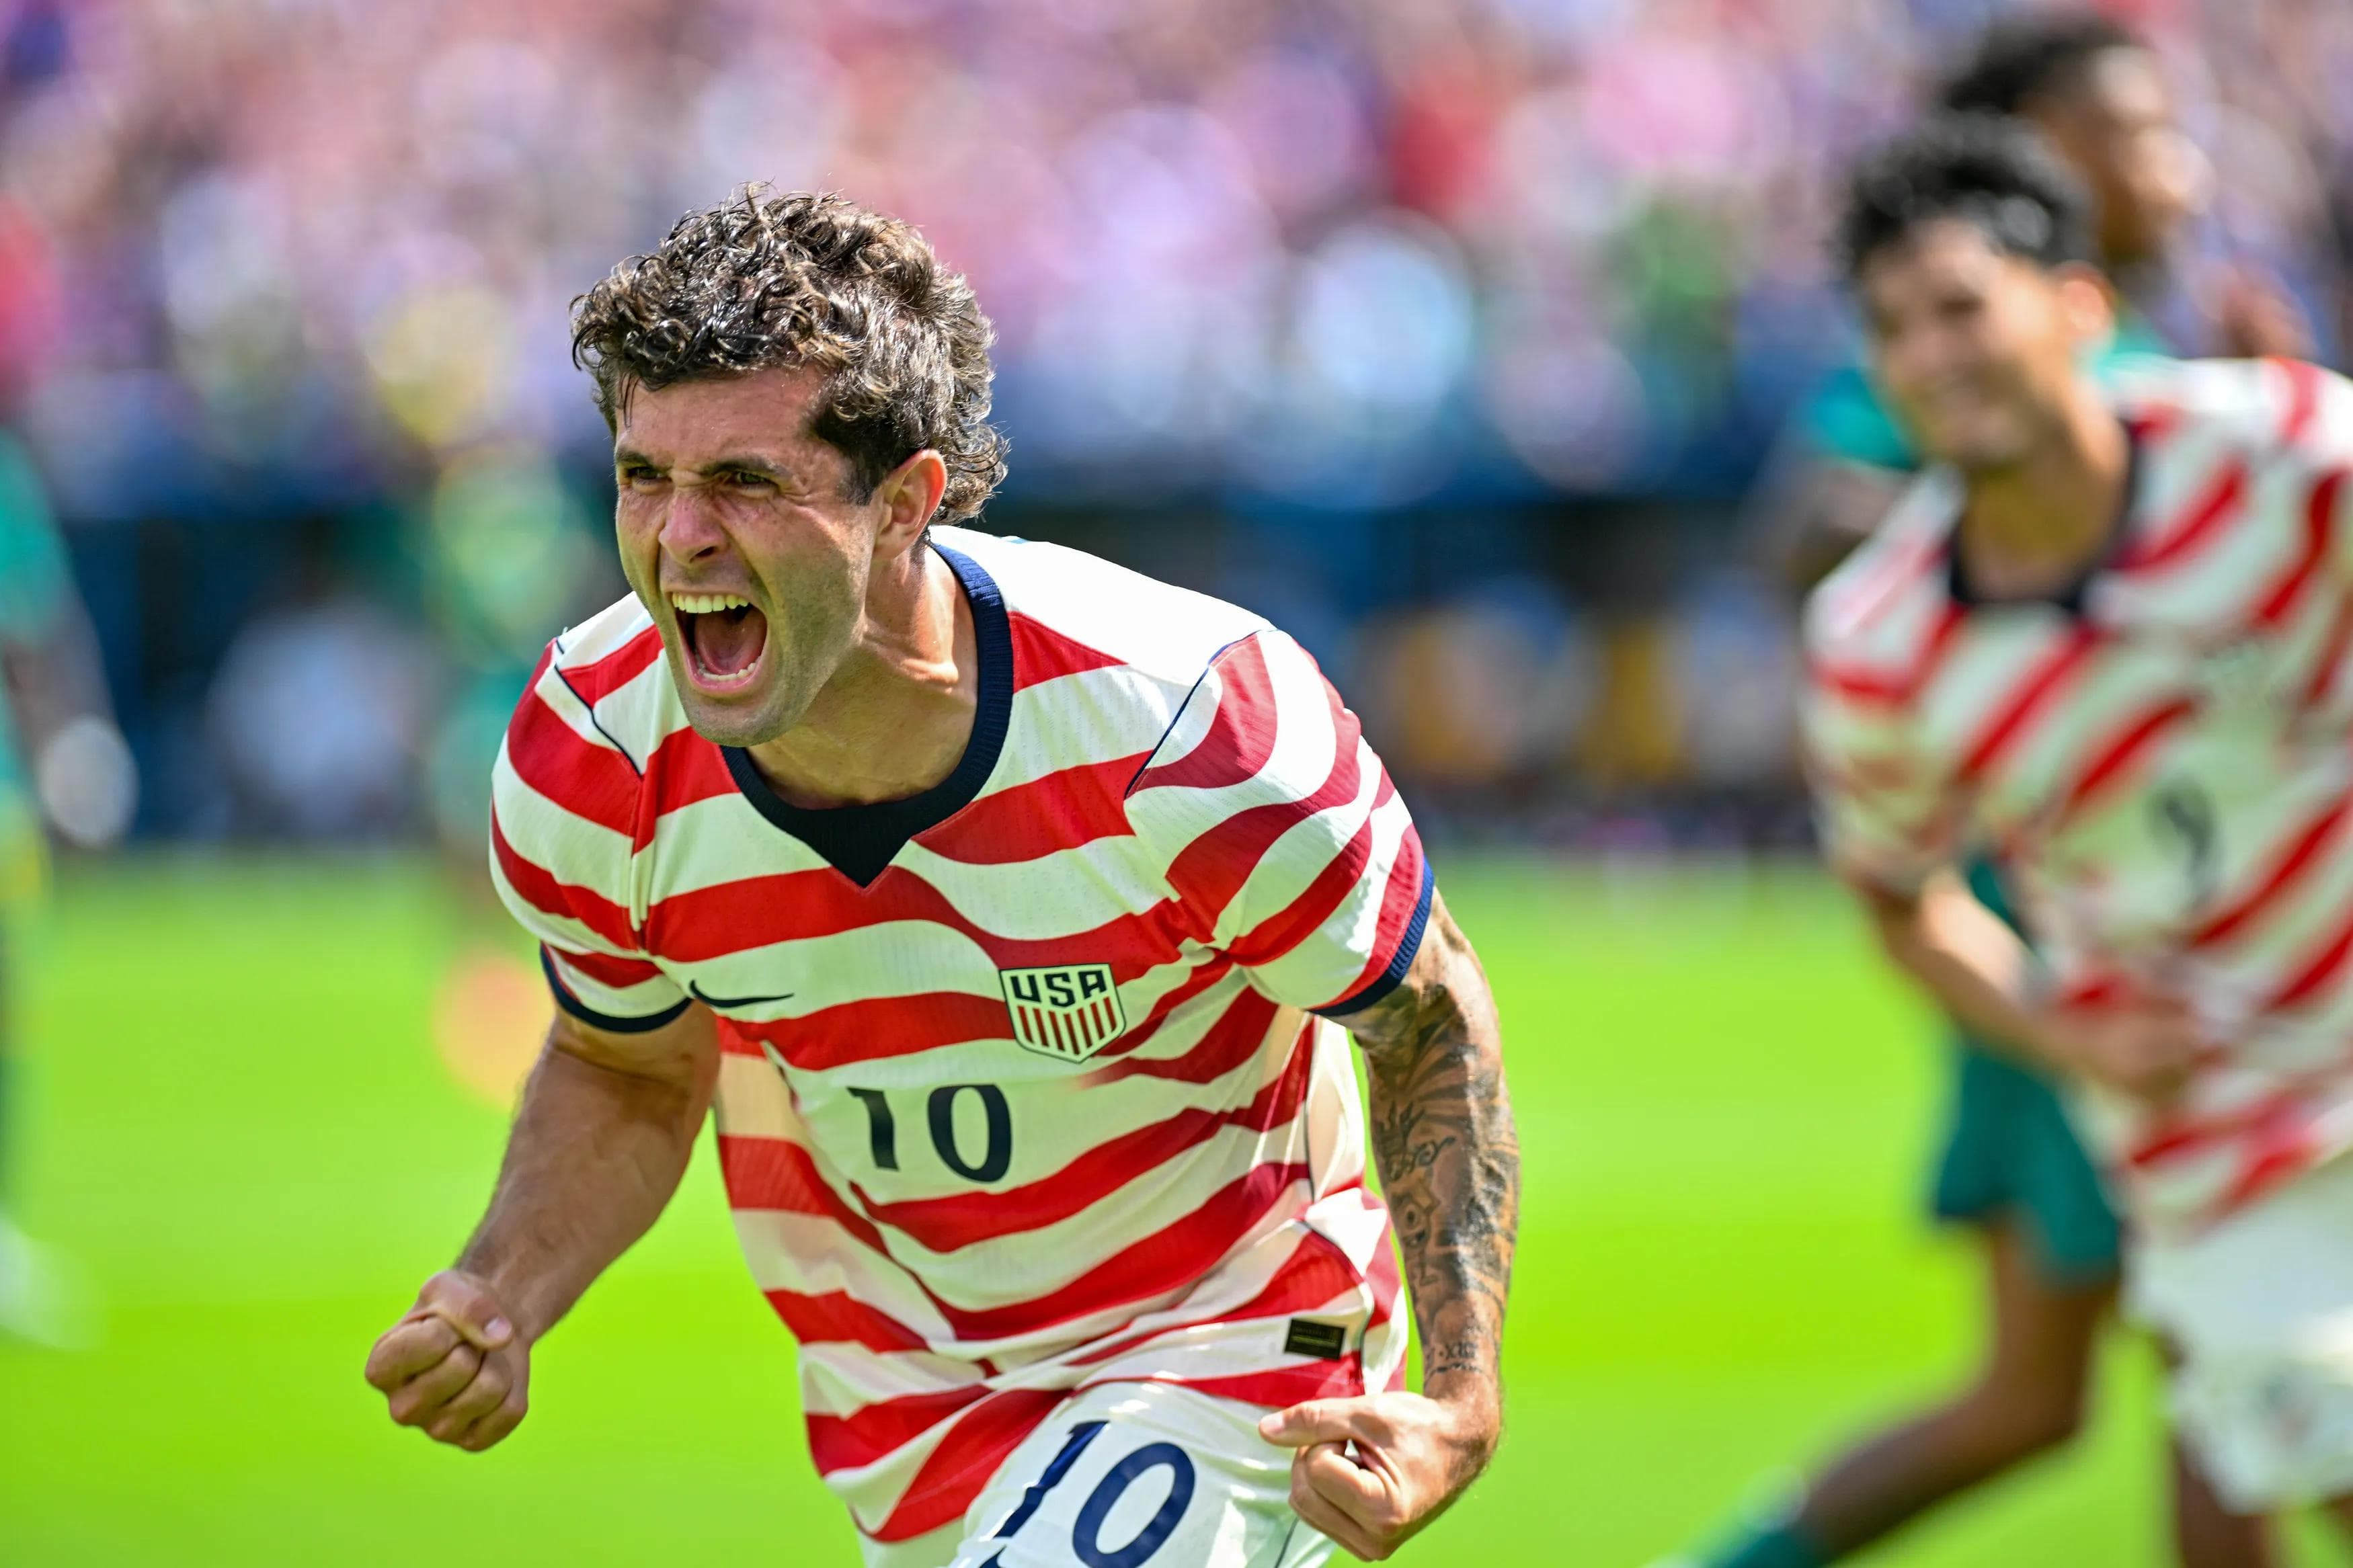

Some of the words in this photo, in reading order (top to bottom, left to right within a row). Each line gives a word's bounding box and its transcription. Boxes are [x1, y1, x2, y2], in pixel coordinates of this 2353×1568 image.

[1010, 970, 1107, 1008] USA
[846, 1083, 1012, 1184] 10
[992, 1419, 1195, 1568] 10
